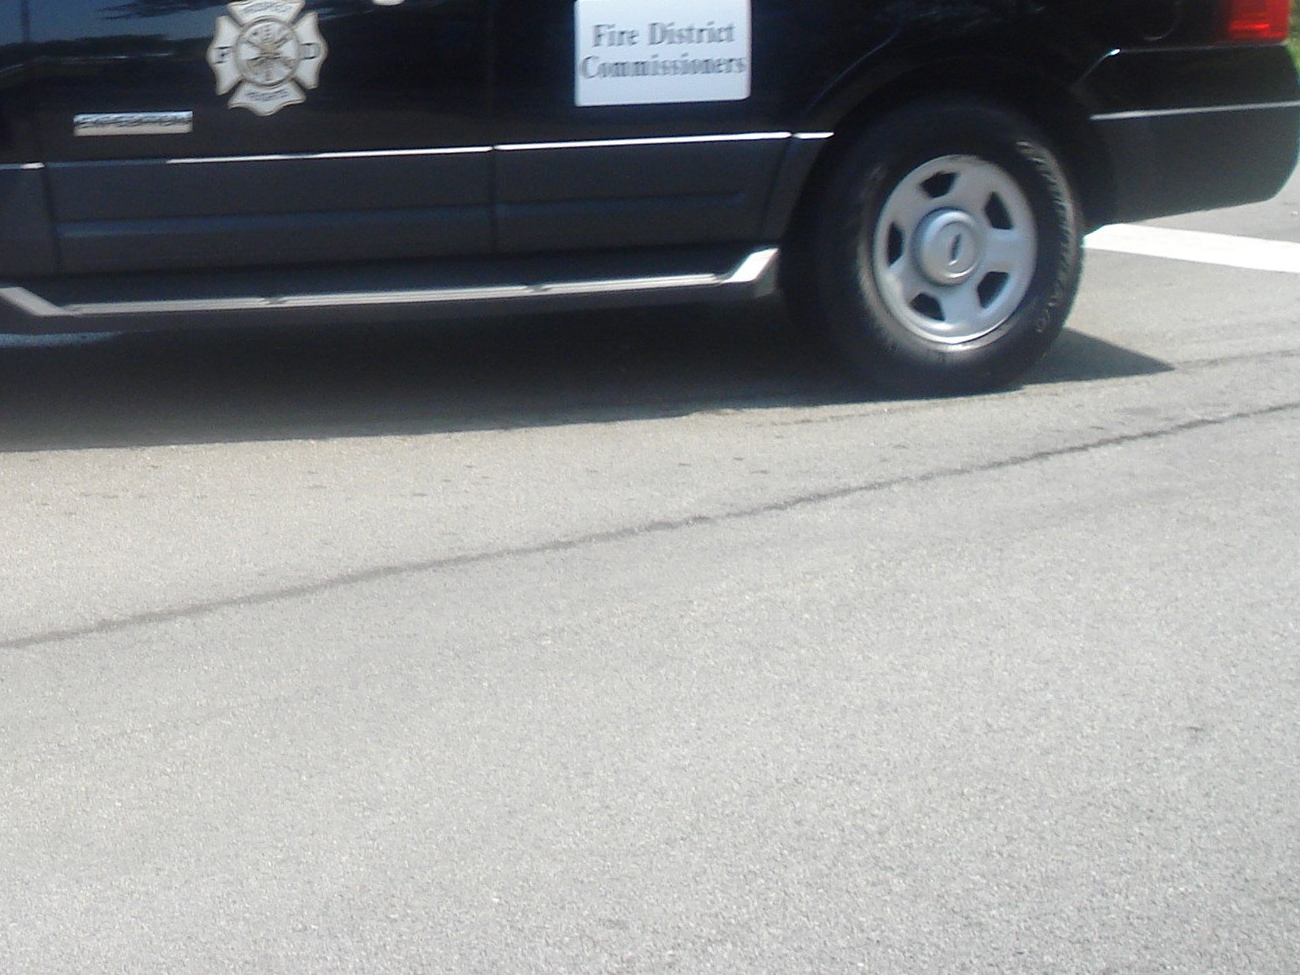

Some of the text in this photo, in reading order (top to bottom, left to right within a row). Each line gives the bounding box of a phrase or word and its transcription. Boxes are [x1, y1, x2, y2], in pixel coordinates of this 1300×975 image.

[593, 21, 735, 47] Fire District
[581, 53, 747, 79] Commissioners
